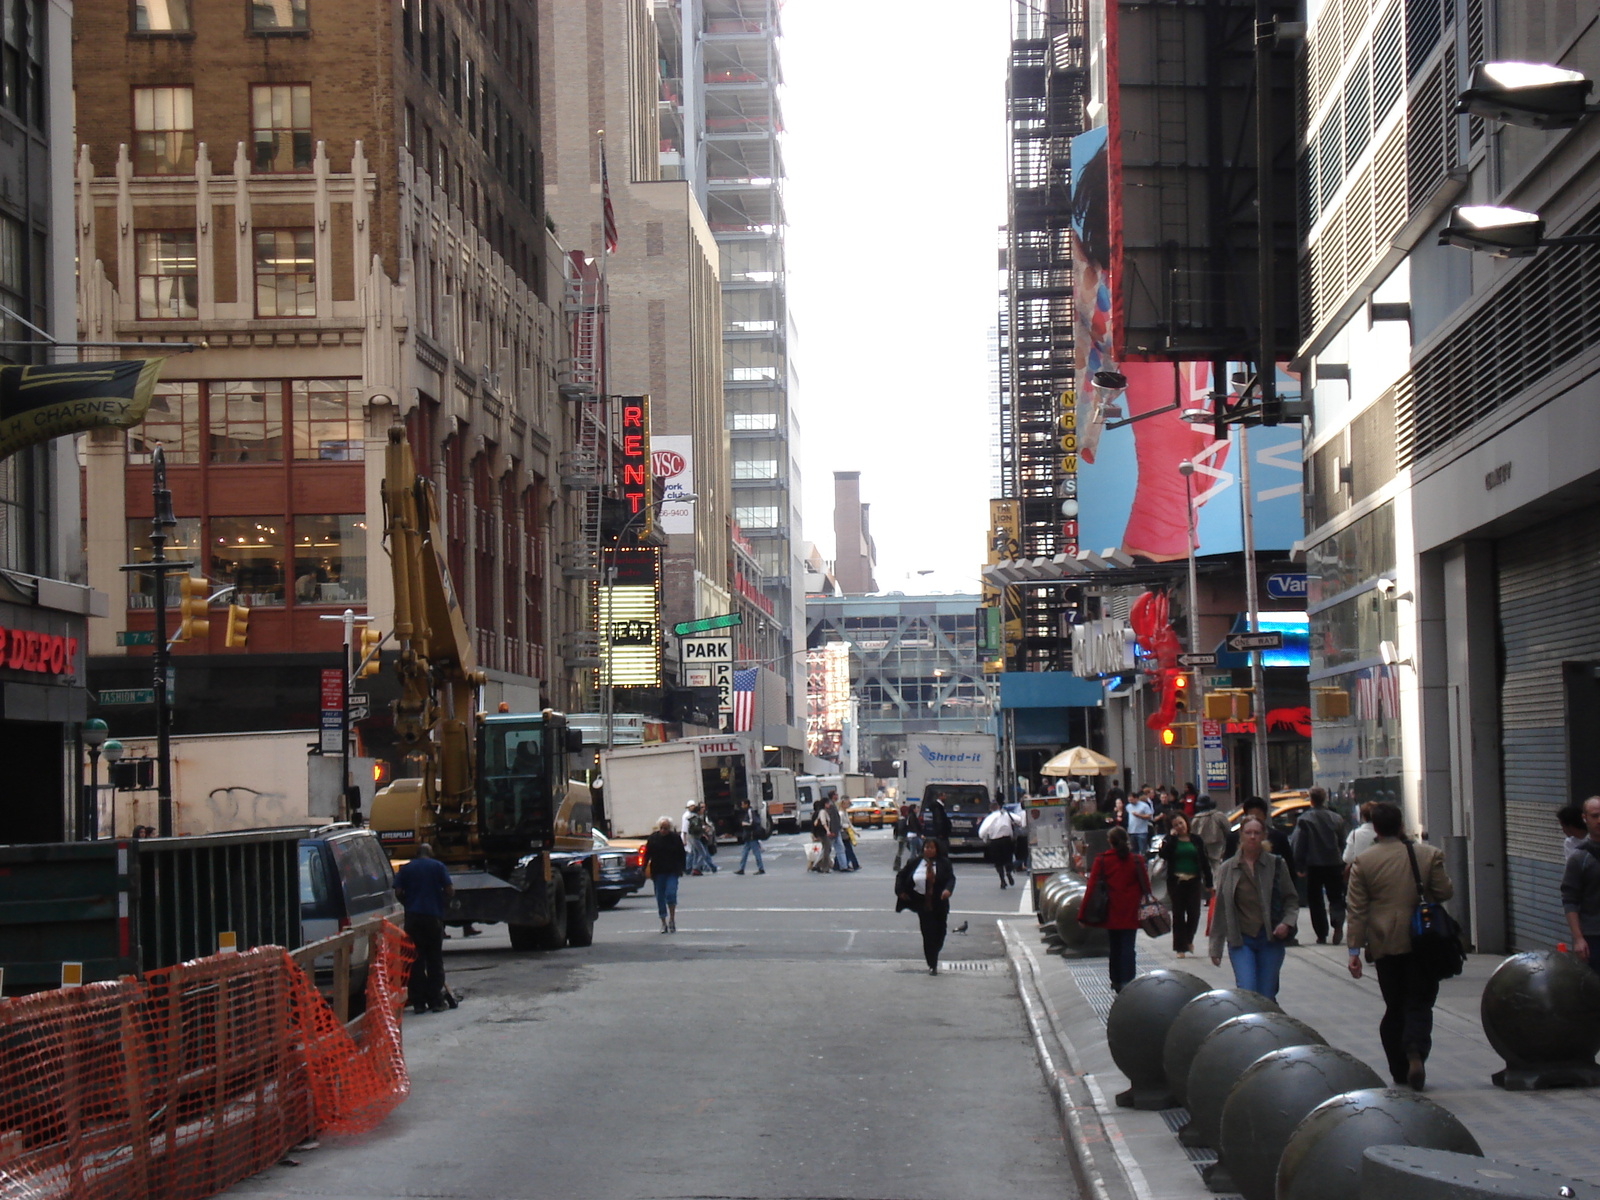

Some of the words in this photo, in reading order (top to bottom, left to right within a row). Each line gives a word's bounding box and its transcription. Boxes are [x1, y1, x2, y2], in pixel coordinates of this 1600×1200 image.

[1065, 394, 1075, 405] N
[34, 401, 130, 426] CHARNEY
[1065, 415, 1074, 427] R
[1065, 436, 1075, 449] Q
[624, 406, 644, 513] RENT
[1065, 459, 1076, 470] W
[1066, 480, 1076, 492] S
[993, 513, 1013, 524] LION
[993, 525, 1013, 535] KNG
[1067, 524, 1074, 535] 1
[1068, 611, 1077, 622] 7
[132, 633, 139, 643] 7
[1234, 638, 1249, 647] ONE
[1258, 637, 1274, 645] WAY
[8, 628, 78, 675] DEPOT
[686, 643, 728, 658] PARK
[718, 665, 730, 706] PARK
[100, 691, 136, 704] FASHION
[628, 718, 637, 727] 41
[928, 751, 982, 762] Shred-it
[381, 831, 413, 839] CATERPILLAR
